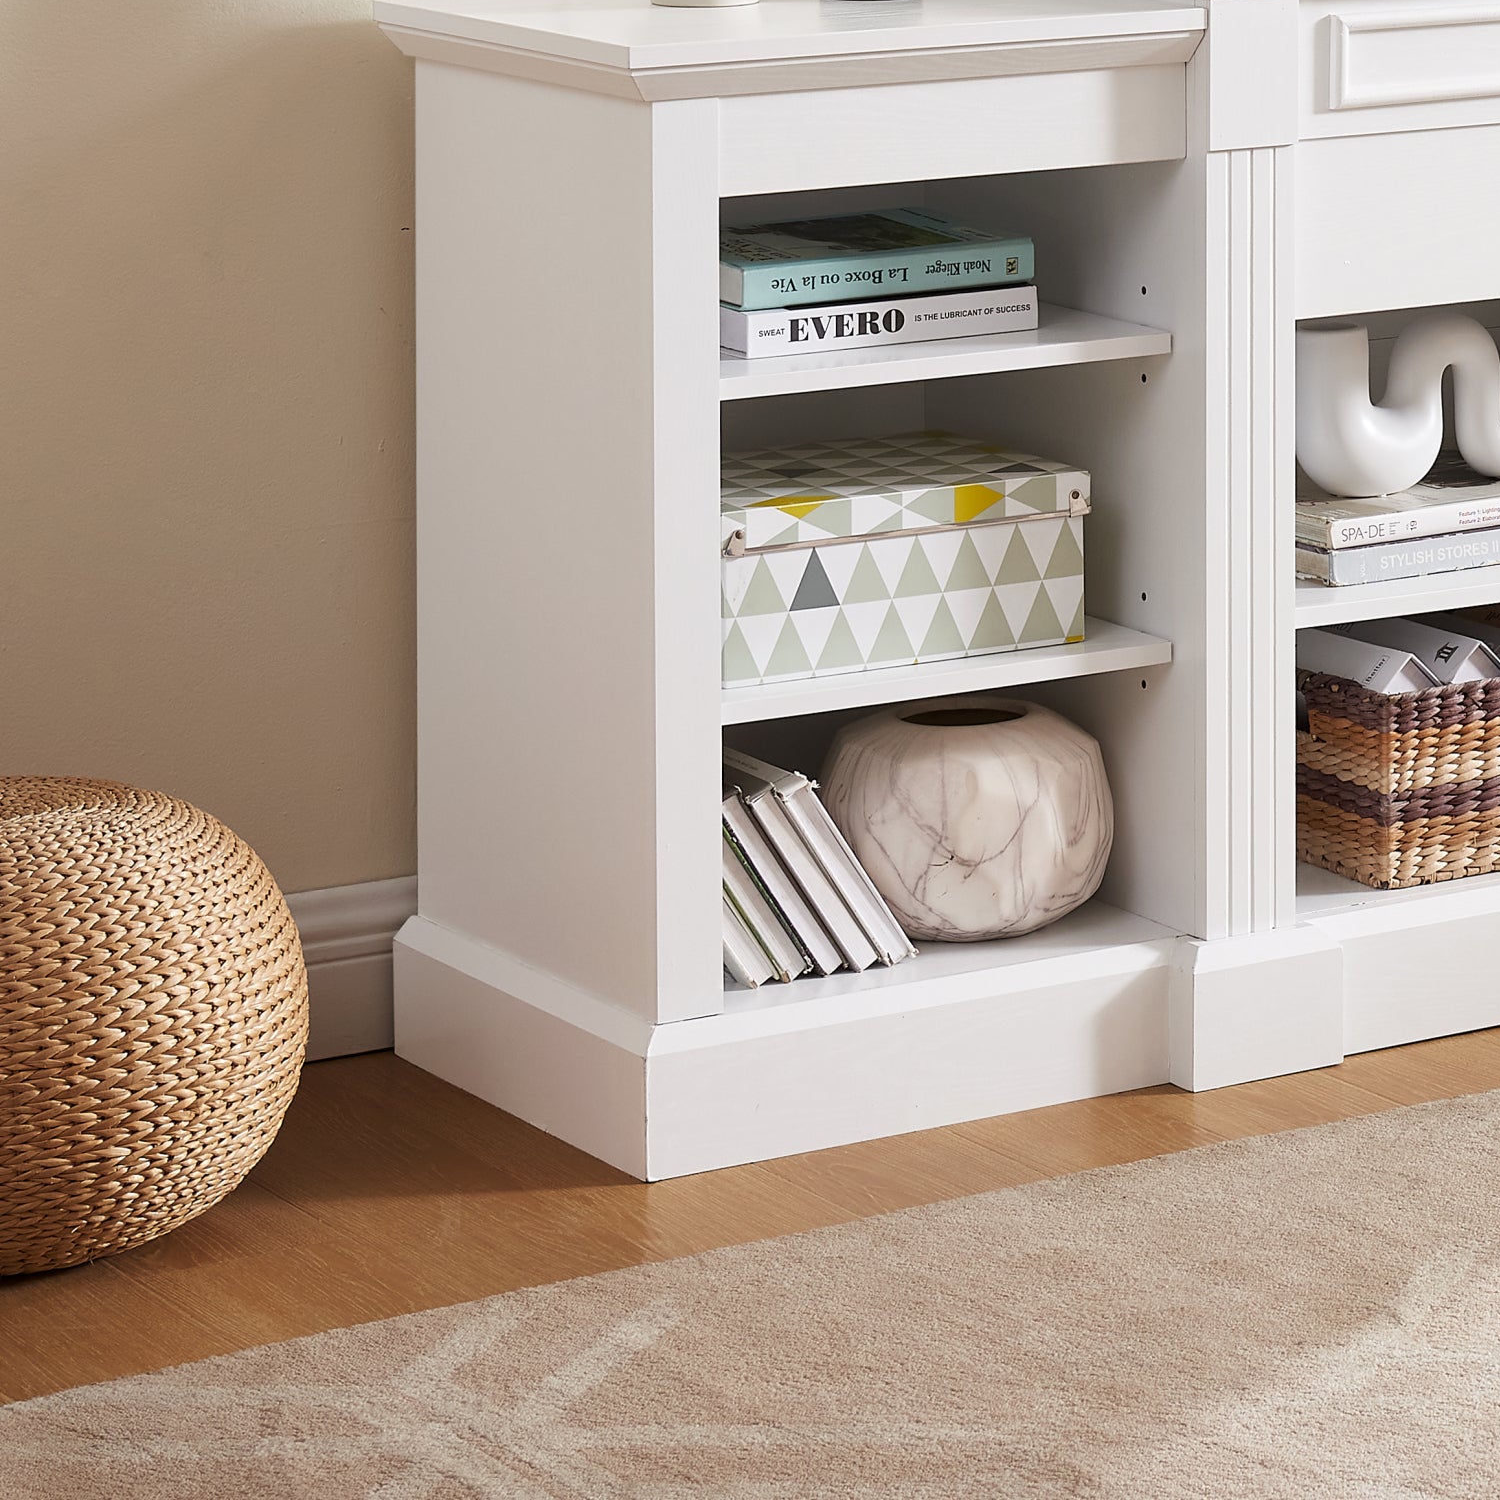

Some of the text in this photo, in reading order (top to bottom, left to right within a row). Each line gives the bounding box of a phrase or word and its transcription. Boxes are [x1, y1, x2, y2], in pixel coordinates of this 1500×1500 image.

[925, 258, 992, 276] Noah Klieger
[771, 267, 908, 294] La Boxe ou la Vie
[914, 303, 1031, 322] IS THE LUBRICANT OF SUCCESS
[758, 327, 785, 338] SWEAT
[788, 308, 905, 343] EVERO
[1482, 506, 1500, 514] Lighting
[1341, 522, 1386, 543] SPA-DE
[1380, 548, 1434, 570] STYLISH
[1436, 543, 1488, 564] STORES
